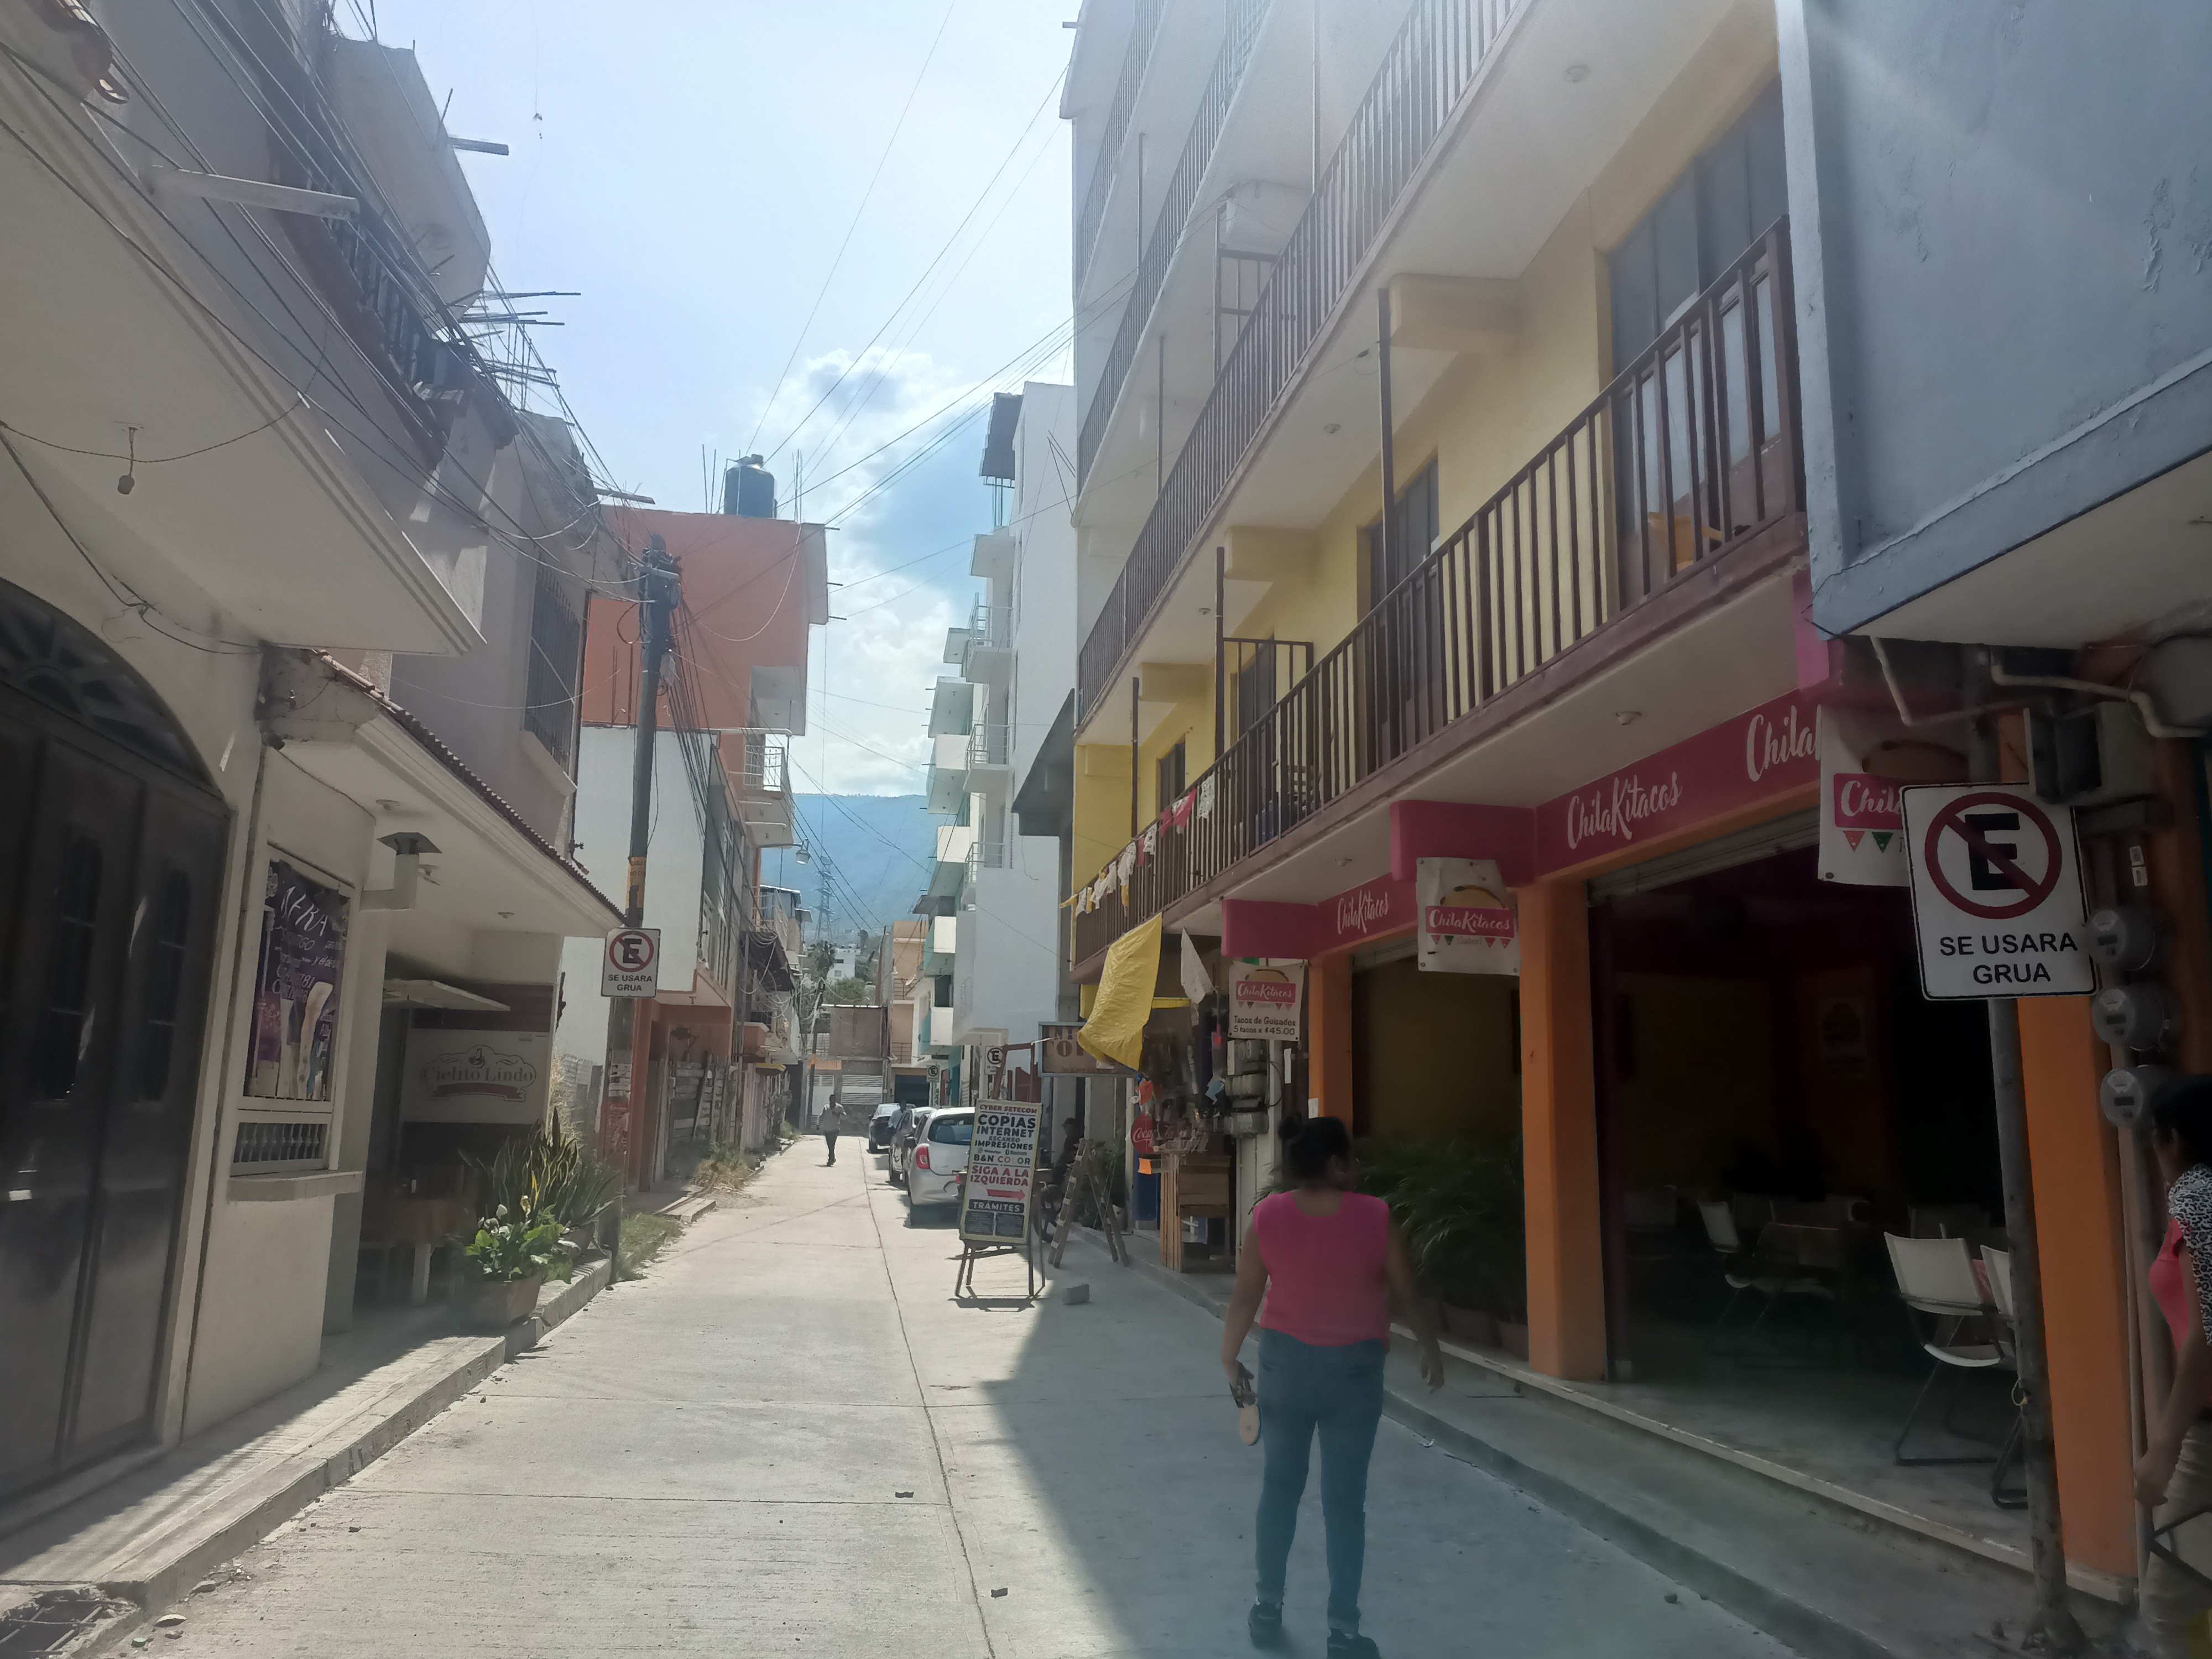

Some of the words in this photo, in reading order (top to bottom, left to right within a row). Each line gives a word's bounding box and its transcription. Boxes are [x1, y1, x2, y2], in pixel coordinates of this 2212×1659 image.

[1567, 771, 1683, 849] ChilaKitacos
[1337, 889, 1389, 935] ChilaKitacos
[1430, 909, 1510, 933] ChilaKitacos
[1940, 936, 1974, 956] SE
[1981, 932, 2078, 954] USARA
[1973, 962, 2051, 984] GRUA
[1238, 983, 1292, 999] ChilaKitacos
[1264, 1017, 1296, 1026] Guisados
[424, 1067, 480, 1081] Cielito
[485, 1067, 533, 1081] Lindo
[978, 1114, 1036, 1129] COPIAS
[977, 1125, 1034, 1138] INTERNET
[974, 1140, 1033, 1150] IMPRESIONES
[972, 1165, 999, 1175] SIGA
[1002, 1168, 1010, 1176] A
[1014, 1168, 1029, 1177] LA
[970, 1175, 1029, 1186] IZQUIERDA
[973, 1201, 1020, 1212] TRÁMITES
